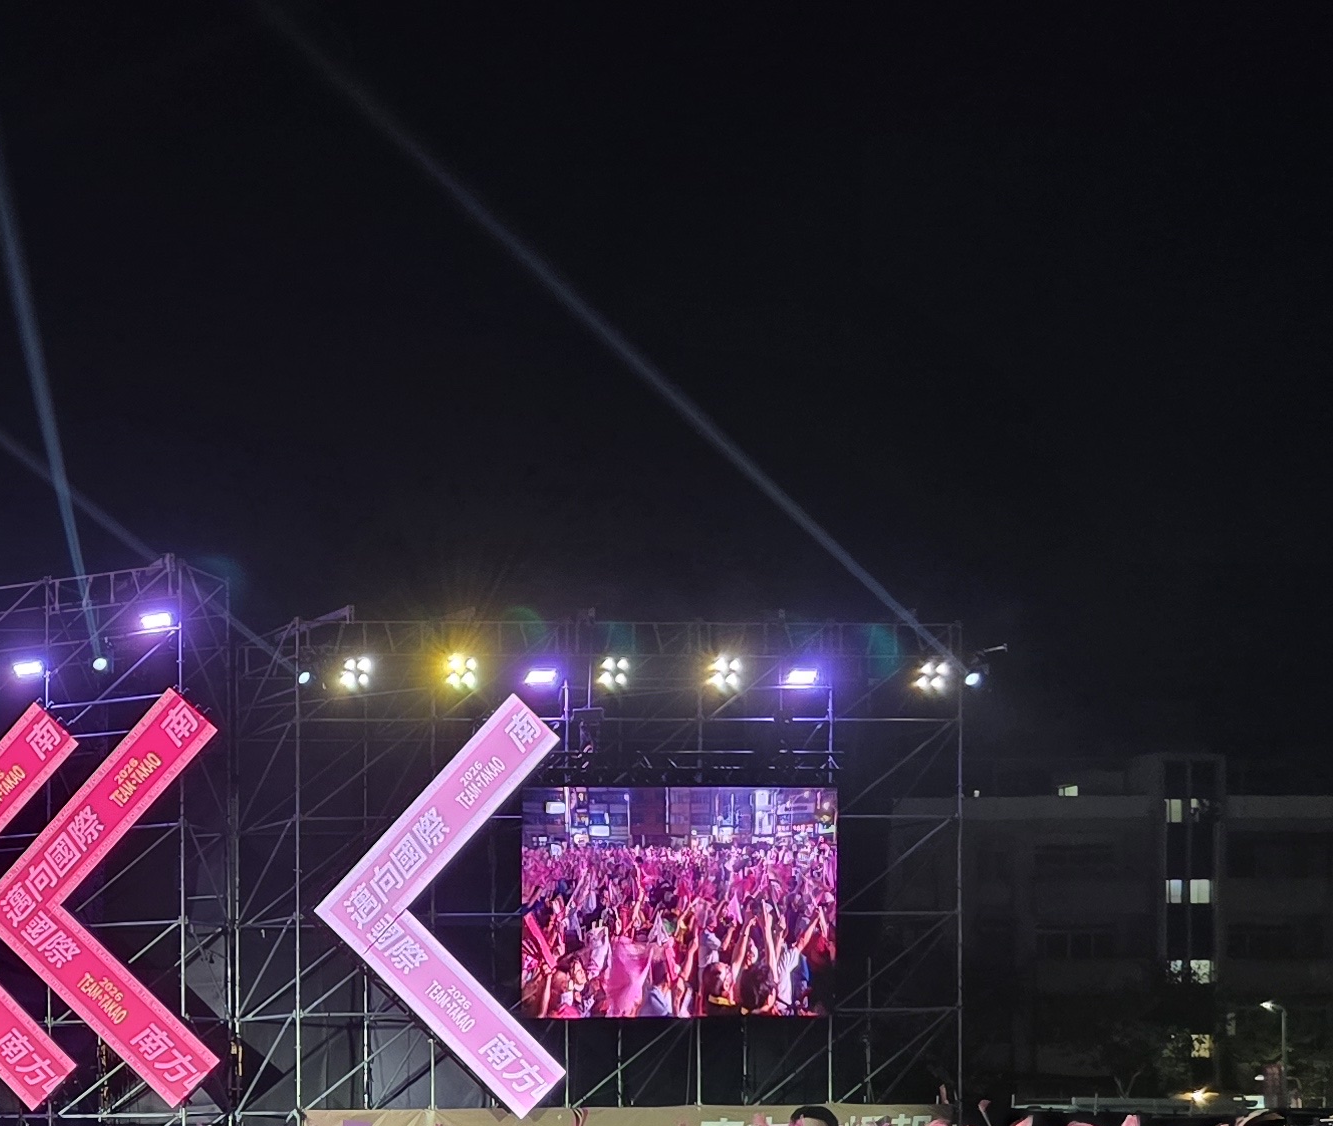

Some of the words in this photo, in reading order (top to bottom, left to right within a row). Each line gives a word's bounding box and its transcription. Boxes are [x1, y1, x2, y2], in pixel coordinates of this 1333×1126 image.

[25, 715, 63, 762] 南
[160, 700, 201, 748] 南
[504, 708, 542, 753] 南
[109, 777, 138, 809] TEAM
[131, 751, 163, 783] TAKAO
[113, 757, 139, 786] 2026
[455, 781, 482, 811] TEAM
[476, 756, 506, 790] TAKAO
[459, 761, 485, 788] 2026
[0, 804, 107, 928] 邁向國際
[343, 806, 450, 930] 邁向國際
[21, 910, 82, 970] 國際
[367, 912, 429, 975] 國際
[76, 971, 103, 1002] TEAM
[98, 993, 129, 1027] TAKAO
[100, 976, 125, 1002] 2026
[424, 979, 450, 1009] TEAM
[446, 1001, 476, 1034] TAKAO
[447, 985, 472, 1011] 2026
